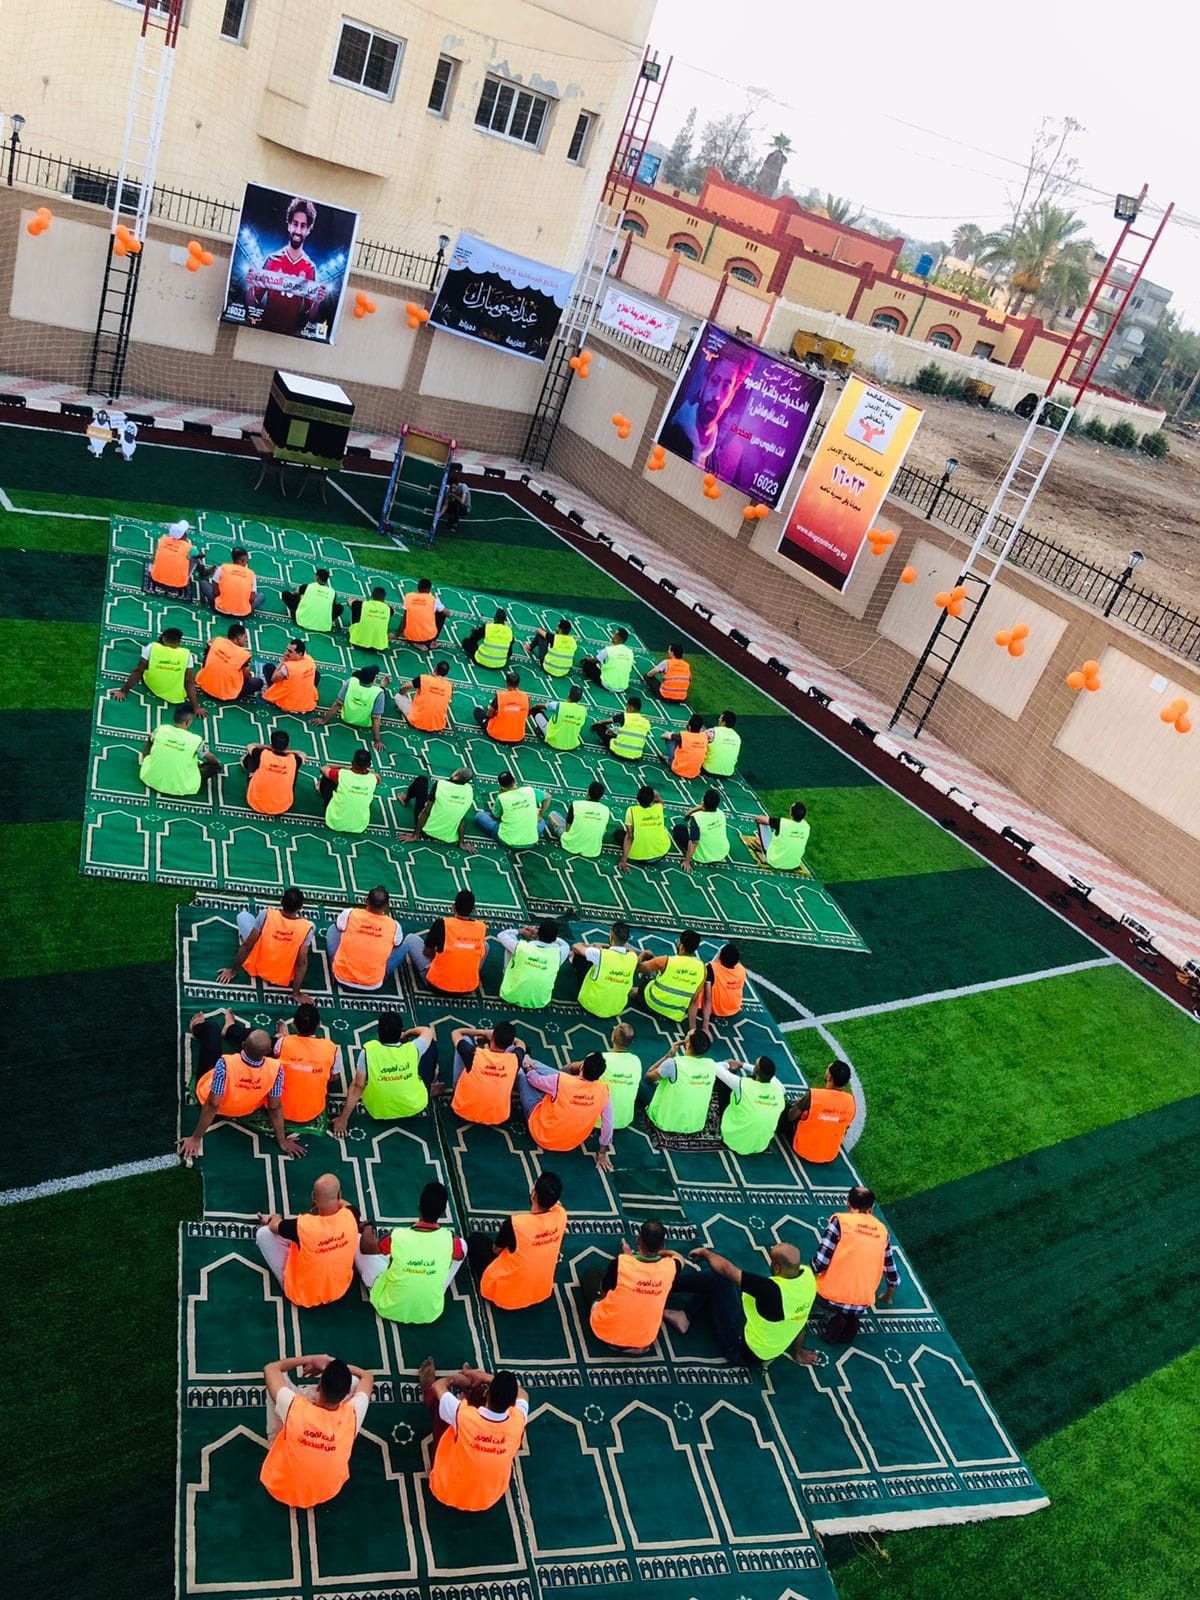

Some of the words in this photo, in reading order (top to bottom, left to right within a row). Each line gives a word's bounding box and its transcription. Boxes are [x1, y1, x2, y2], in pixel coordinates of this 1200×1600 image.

[491, 262, 516, 276] 16023
[778, 391, 810, 415] المخدرات
[752, 472, 779, 495] 16023
[832, 465, 866, 495] ١٦٠٢٣
